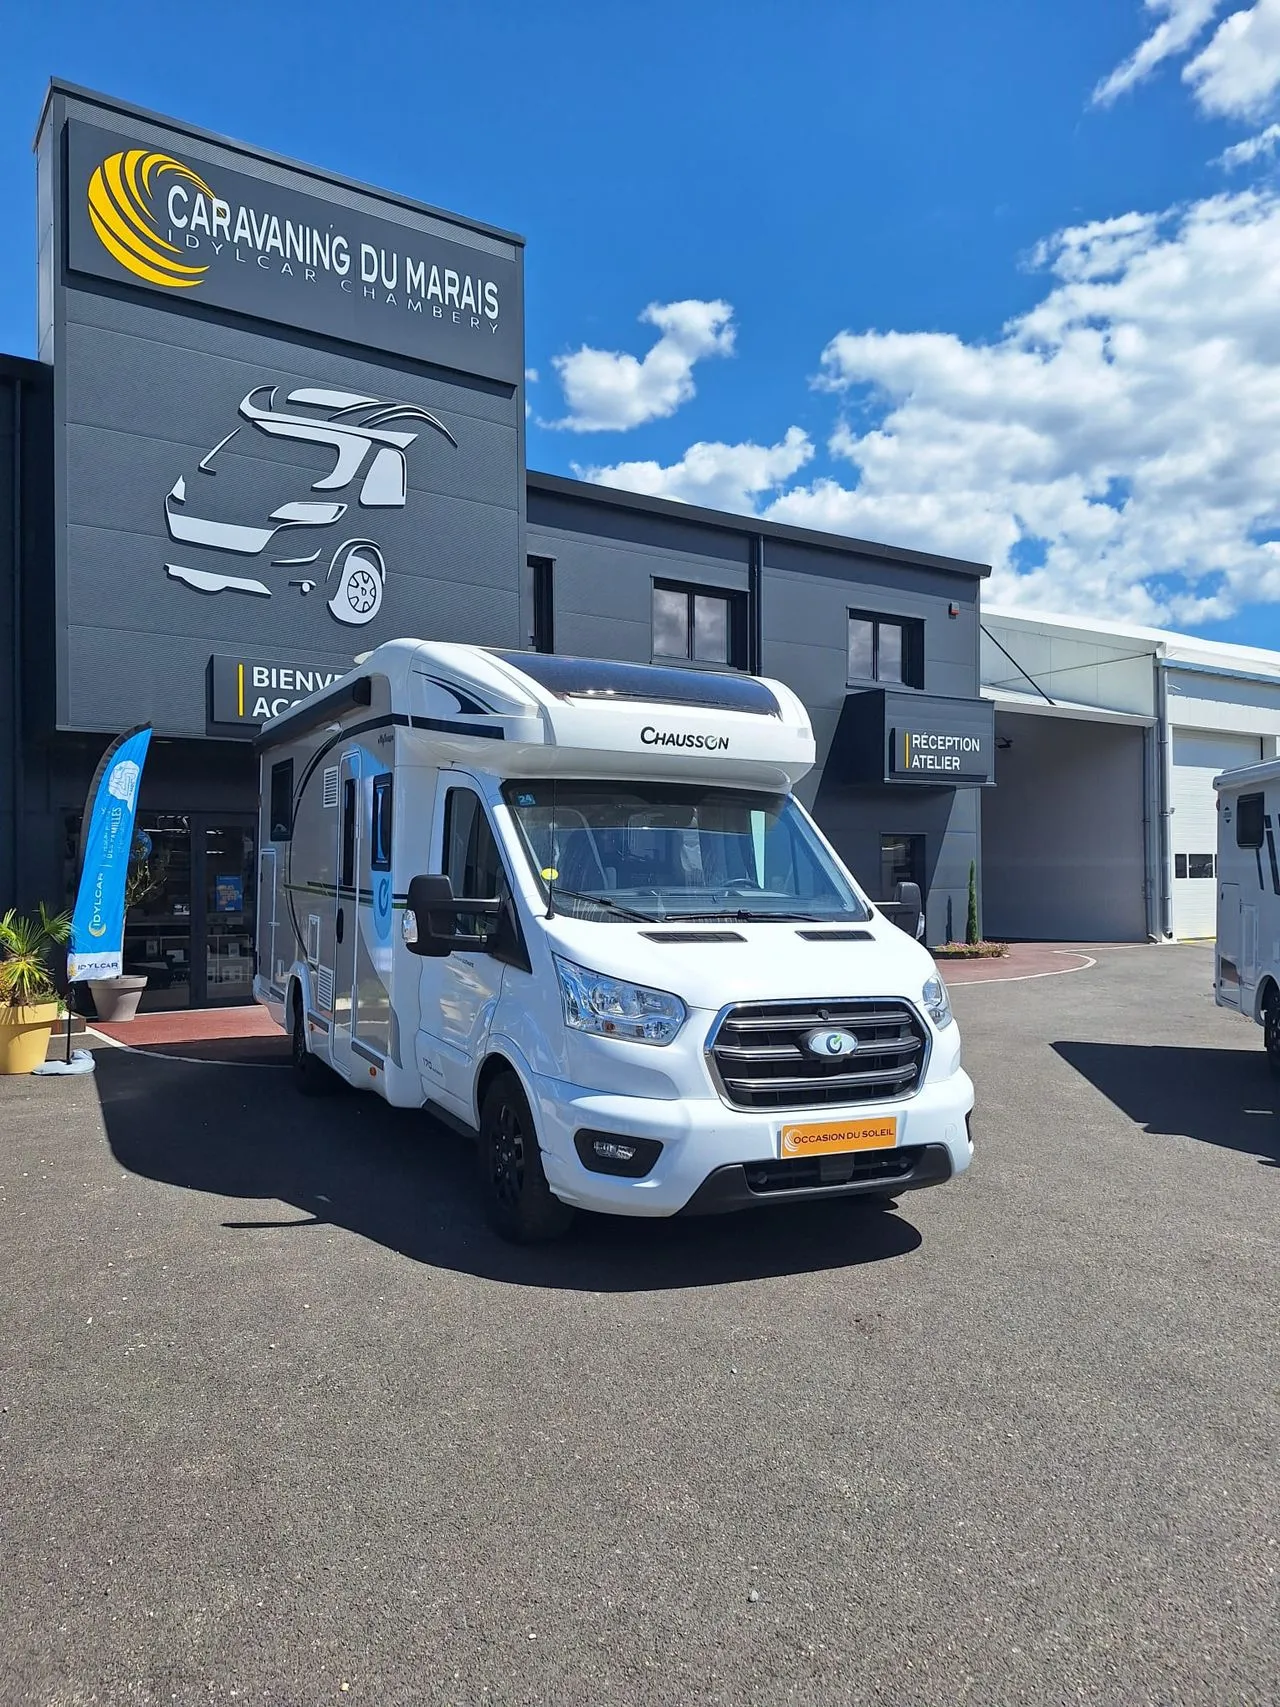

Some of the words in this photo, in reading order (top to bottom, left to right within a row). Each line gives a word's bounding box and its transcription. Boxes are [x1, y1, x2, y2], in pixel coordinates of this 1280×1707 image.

[167, 184, 352, 275] CARAVANING
[361, 244, 397, 290] DU
[405, 256, 499, 320] MARAIS
[167, 229, 317, 283] IDYLCAR
[341, 279, 499, 334] CHAMBERY
[912, 732, 980, 752] RÉCEPTION
[911, 755, 961, 770] ATELIER
[93, 872, 104, 926] IDYLCAR
[77, 962, 119, 971] IDYLCAR
[793, 1132, 845, 1145] OCCASION
[846, 1131, 860, 1140] DU
[862, 1128, 894, 1138] SOLEIL
